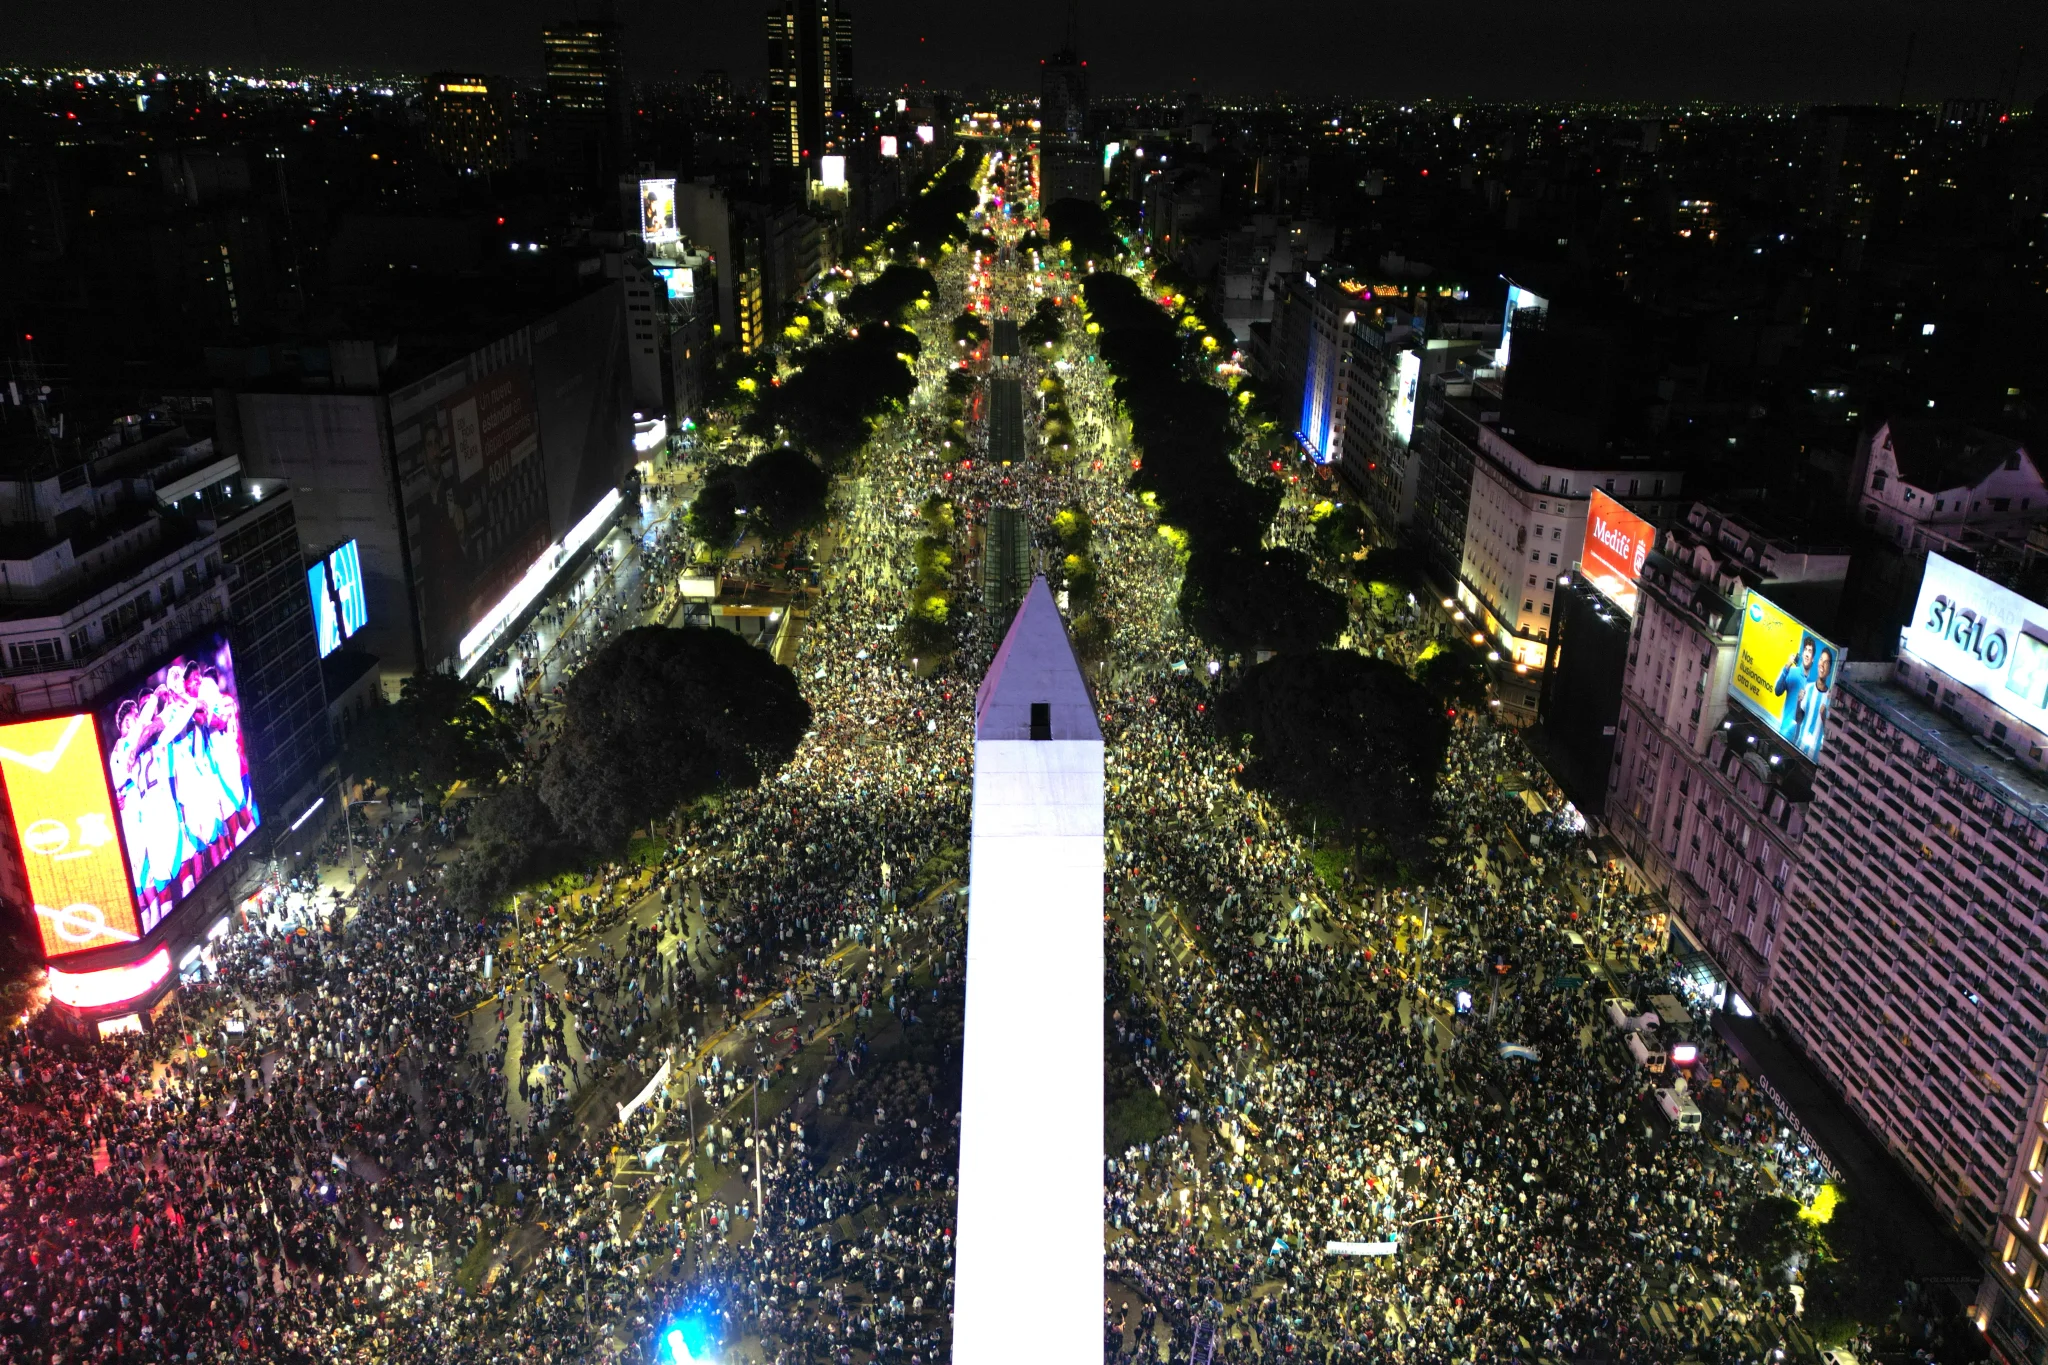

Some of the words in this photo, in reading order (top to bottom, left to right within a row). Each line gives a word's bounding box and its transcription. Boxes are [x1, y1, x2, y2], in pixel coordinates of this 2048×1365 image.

[491, 381, 513, 405] nuevo
[513, 397, 522, 414] en
[484, 413, 532, 457] departamentos
[1593, 516, 1631, 560] Medifé
[1925, 596, 2008, 670] SIGLO
[1741, 648, 1755, 666] Nos
[1737, 674, 1749, 689] otra
[1749, 682, 1761, 696] vez
[1739, 661, 1774, 694] ilusionamos
[1759, 1074, 1801, 1132] GLOBALES
